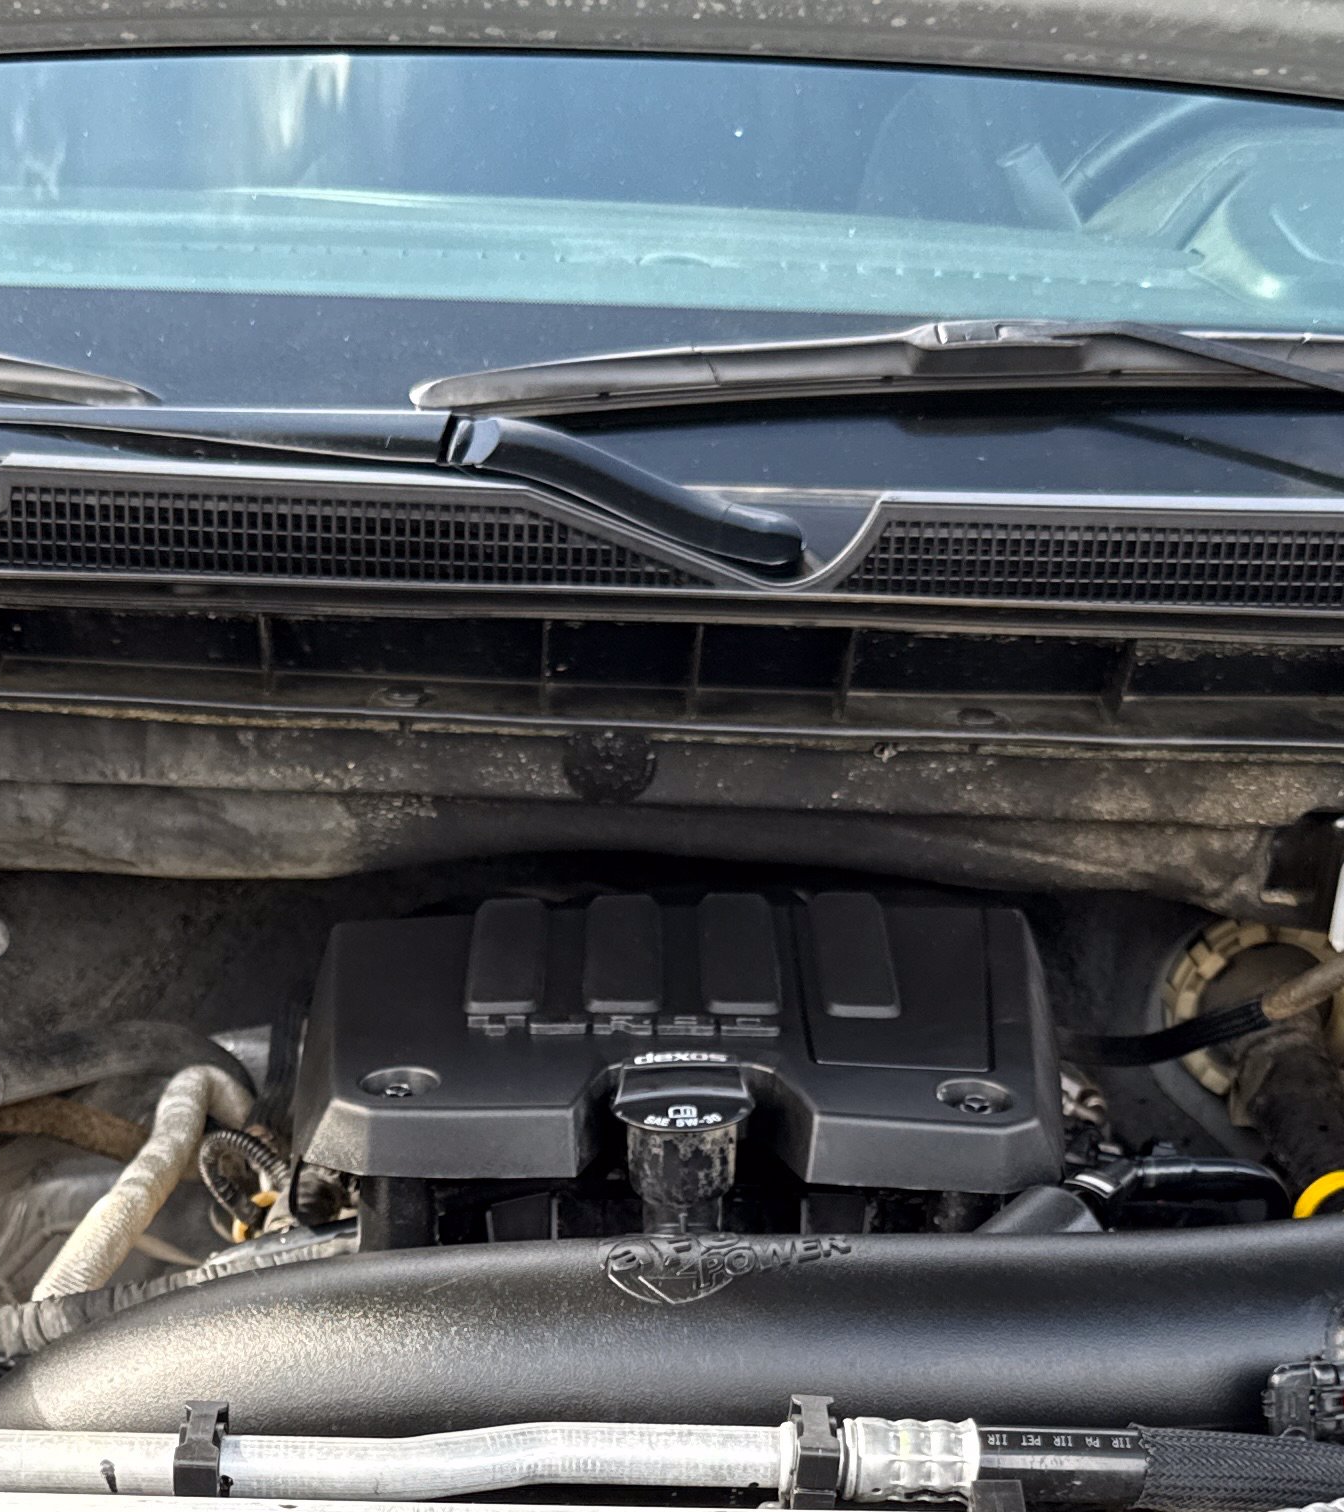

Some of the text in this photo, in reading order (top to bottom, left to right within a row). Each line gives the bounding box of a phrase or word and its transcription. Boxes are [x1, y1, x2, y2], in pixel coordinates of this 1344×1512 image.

[634, 1052, 728, 1065] dexos
[644, 1112, 723, 1128] SAE 5W-30
[698, 1234, 853, 1290] POWER
[1020, 1434, 1042, 1447] PET
